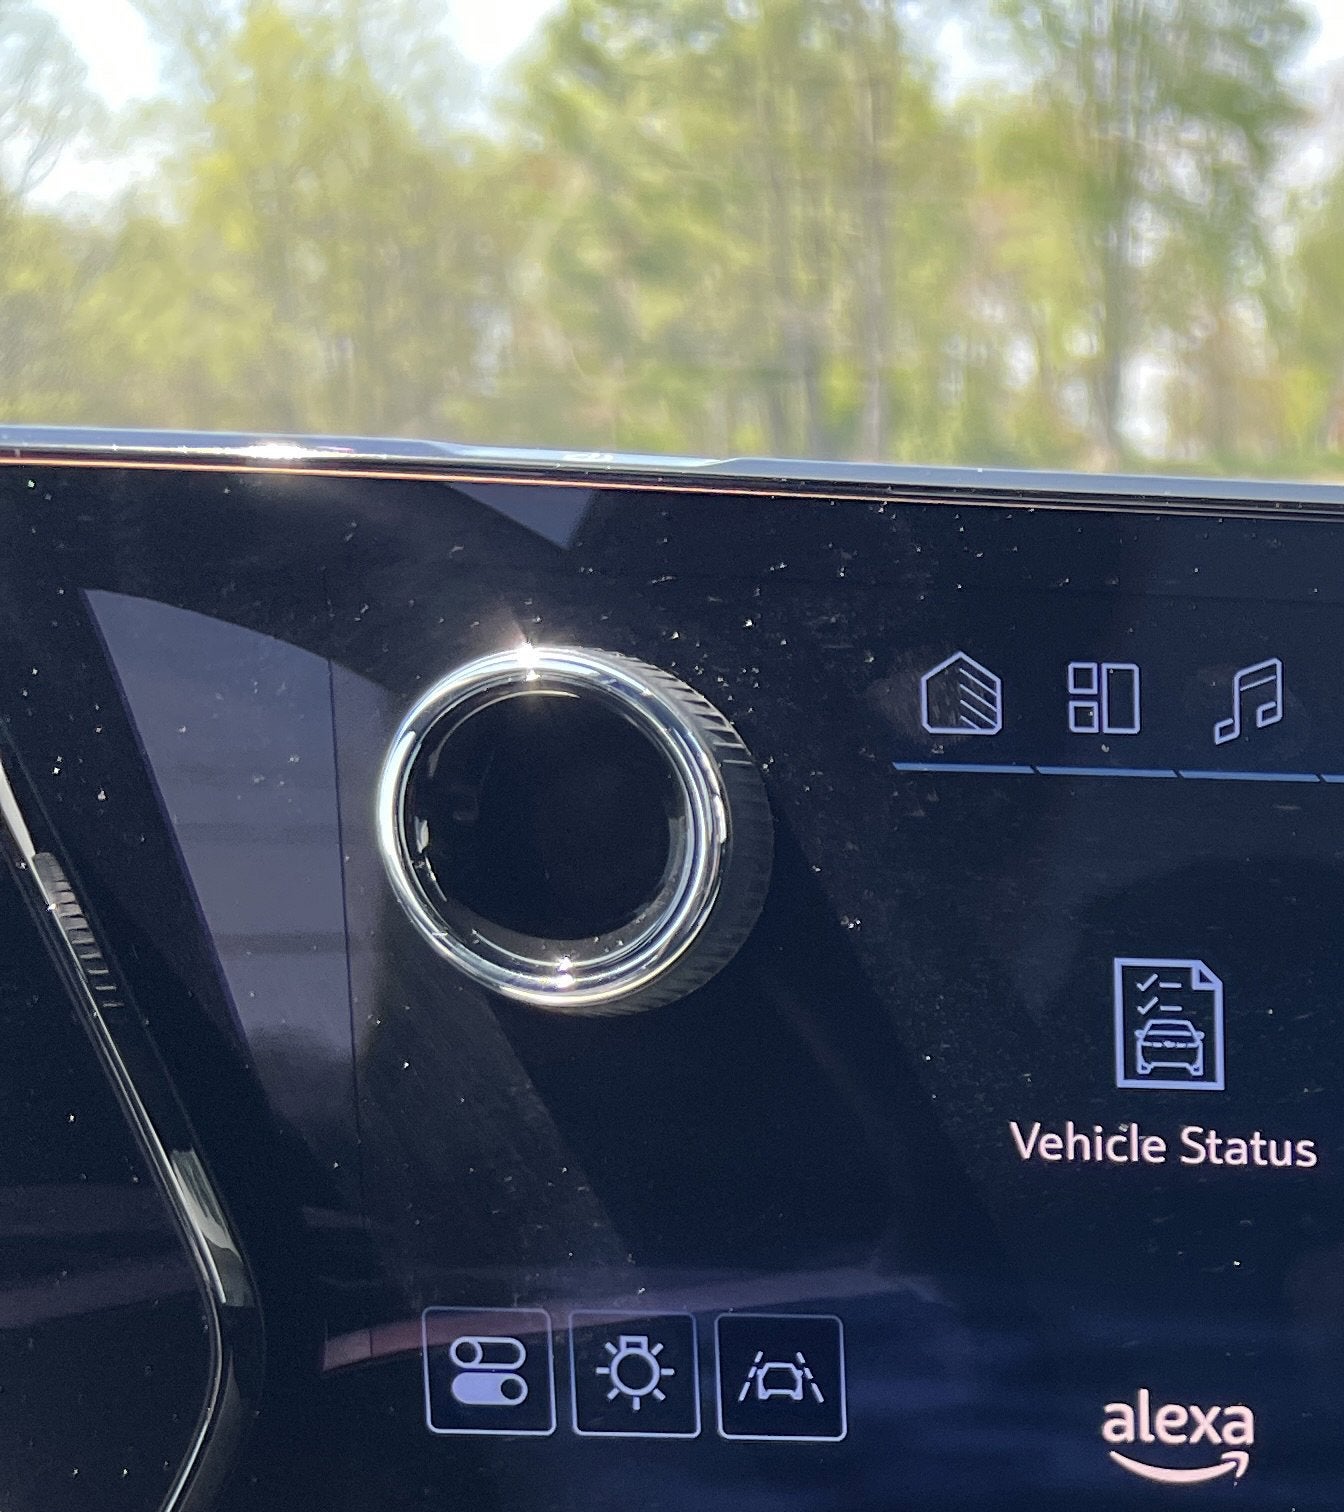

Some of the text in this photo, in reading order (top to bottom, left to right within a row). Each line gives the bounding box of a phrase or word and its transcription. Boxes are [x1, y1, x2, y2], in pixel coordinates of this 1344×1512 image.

[1009, 1120, 1318, 1169] Vehicle Status
[1101, 1387, 1255, 1446] alexa
